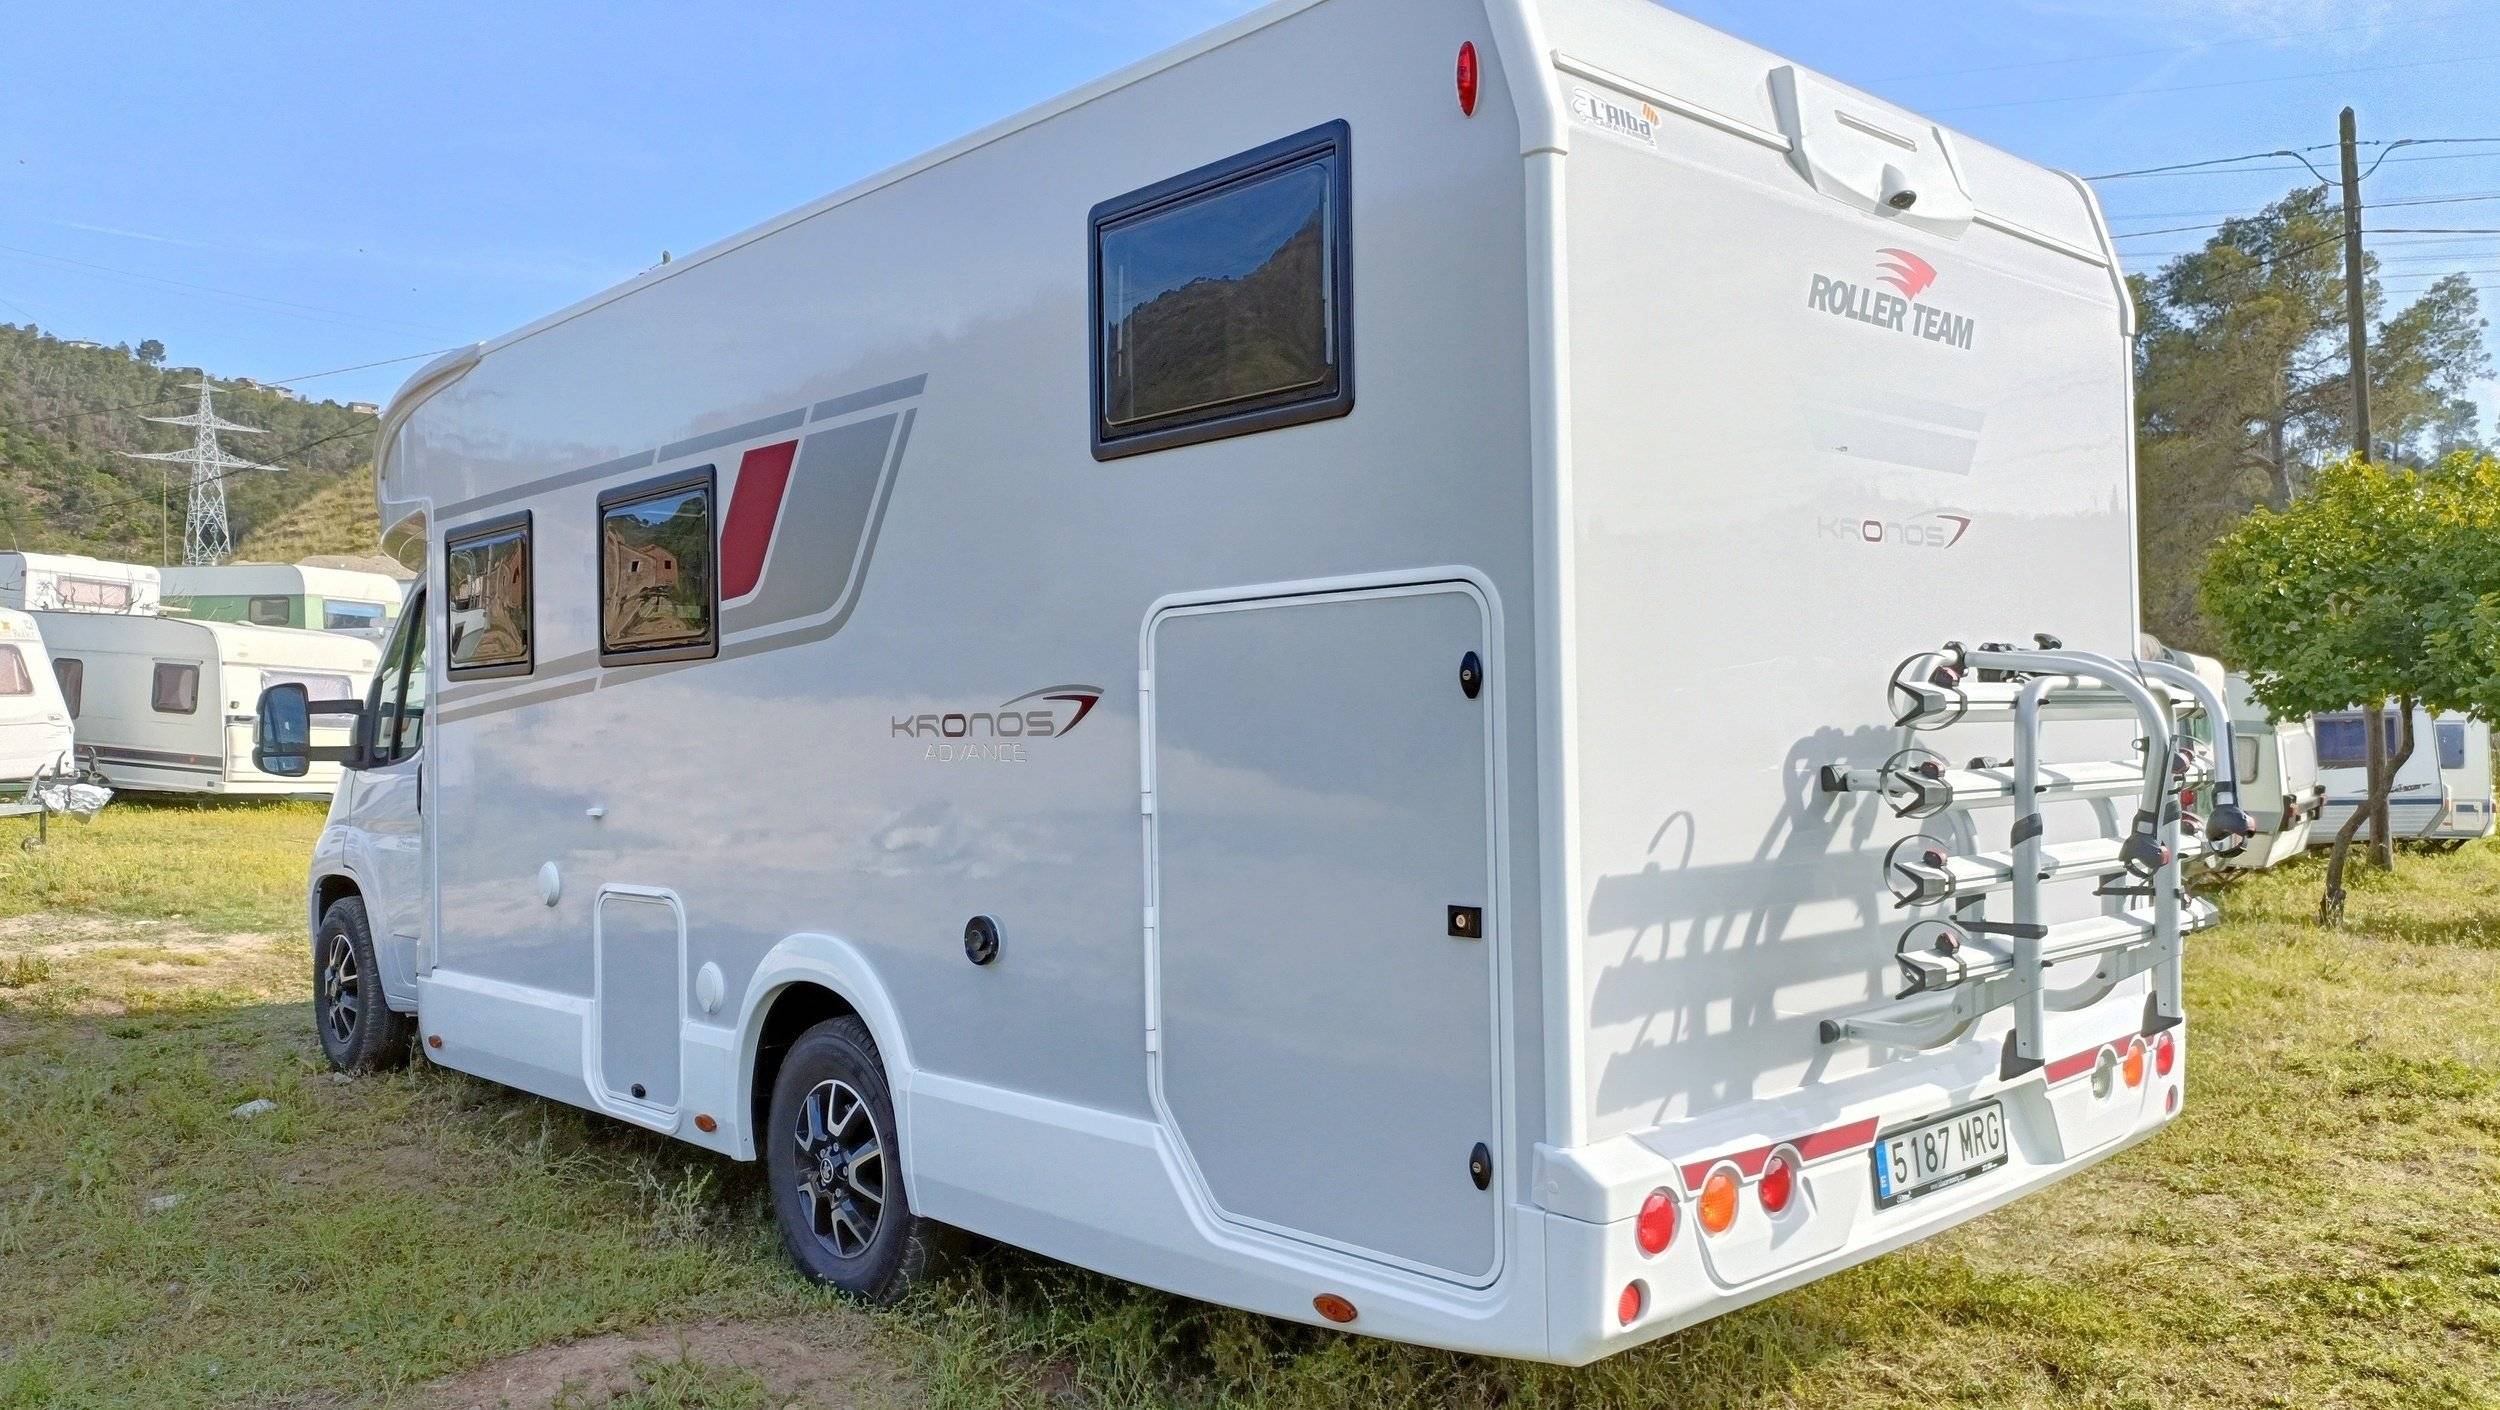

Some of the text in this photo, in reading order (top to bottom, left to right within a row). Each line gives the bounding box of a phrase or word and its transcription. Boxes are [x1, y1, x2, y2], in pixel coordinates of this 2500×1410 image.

[1807, 272, 1975, 351] ROLLER TEAM
[1817, 516, 1945, 547] KRONOS
[891, 710, 1055, 738] KRONOS
[923, 743, 1028, 763] ADVANCE
[1891, 1126, 1950, 1184] 5187
[1958, 1111, 2000, 1162] MRG
